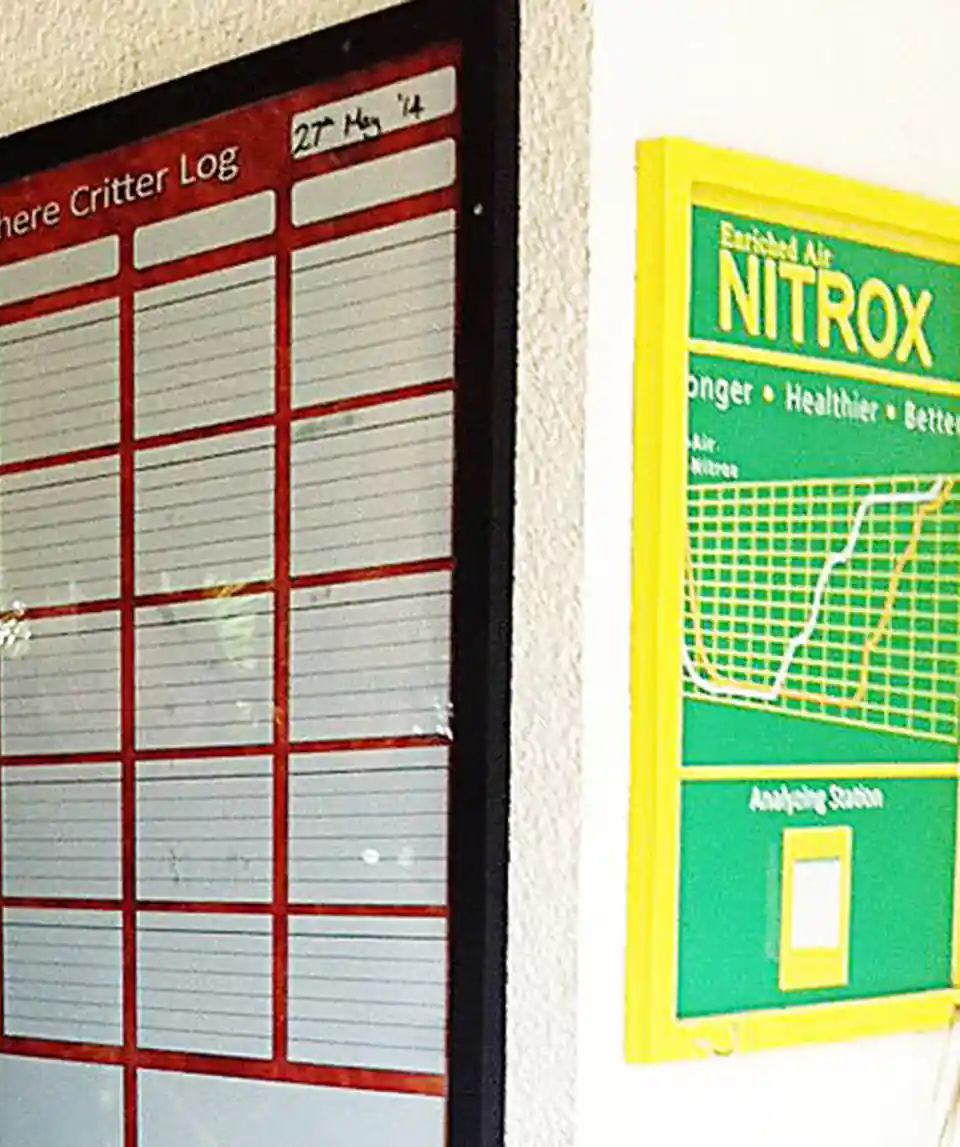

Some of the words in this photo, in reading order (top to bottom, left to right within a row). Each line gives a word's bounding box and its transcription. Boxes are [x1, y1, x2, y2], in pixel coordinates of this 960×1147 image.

[345, 107, 382, 140] May
[70, 167, 169, 217] Critter
[180, 146, 240, 186] Log
[720, 220, 798, 263] Enriched
[803, 239, 833, 268] Air
[718, 249, 933, 369] NITROX
[688, 374, 753, 412] onger
[785, 382, 879, 422] Healthier
[828, 783, 884, 811] Station
